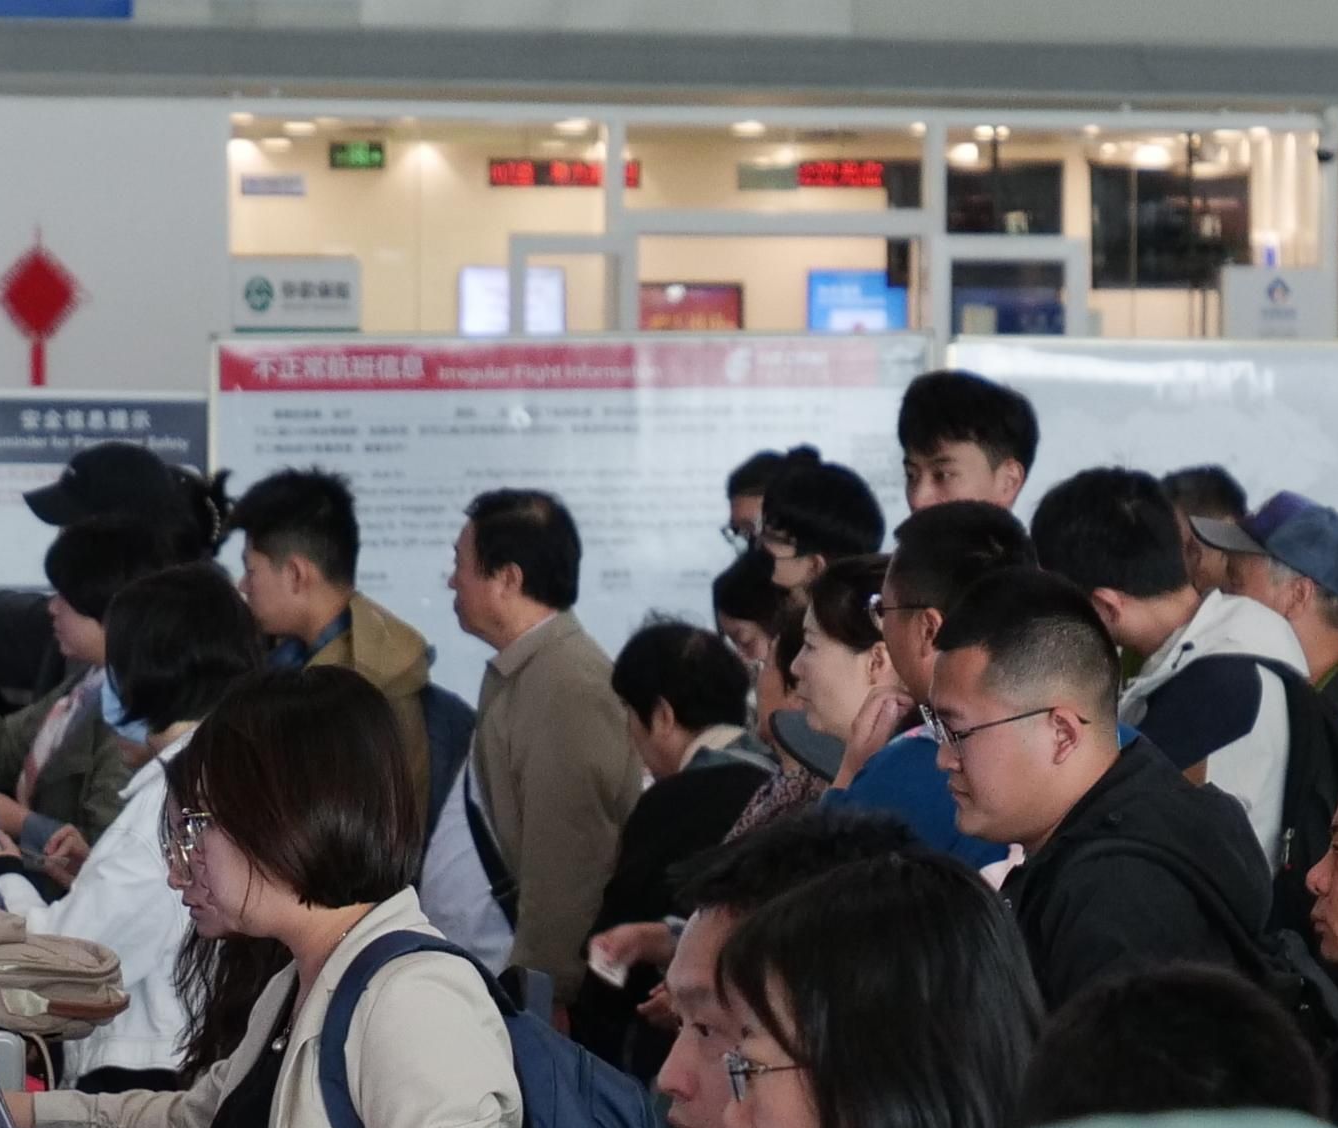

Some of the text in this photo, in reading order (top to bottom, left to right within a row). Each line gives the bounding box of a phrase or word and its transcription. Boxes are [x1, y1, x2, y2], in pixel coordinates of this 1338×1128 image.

[253, 355, 425, 381] 不正常航班信息
